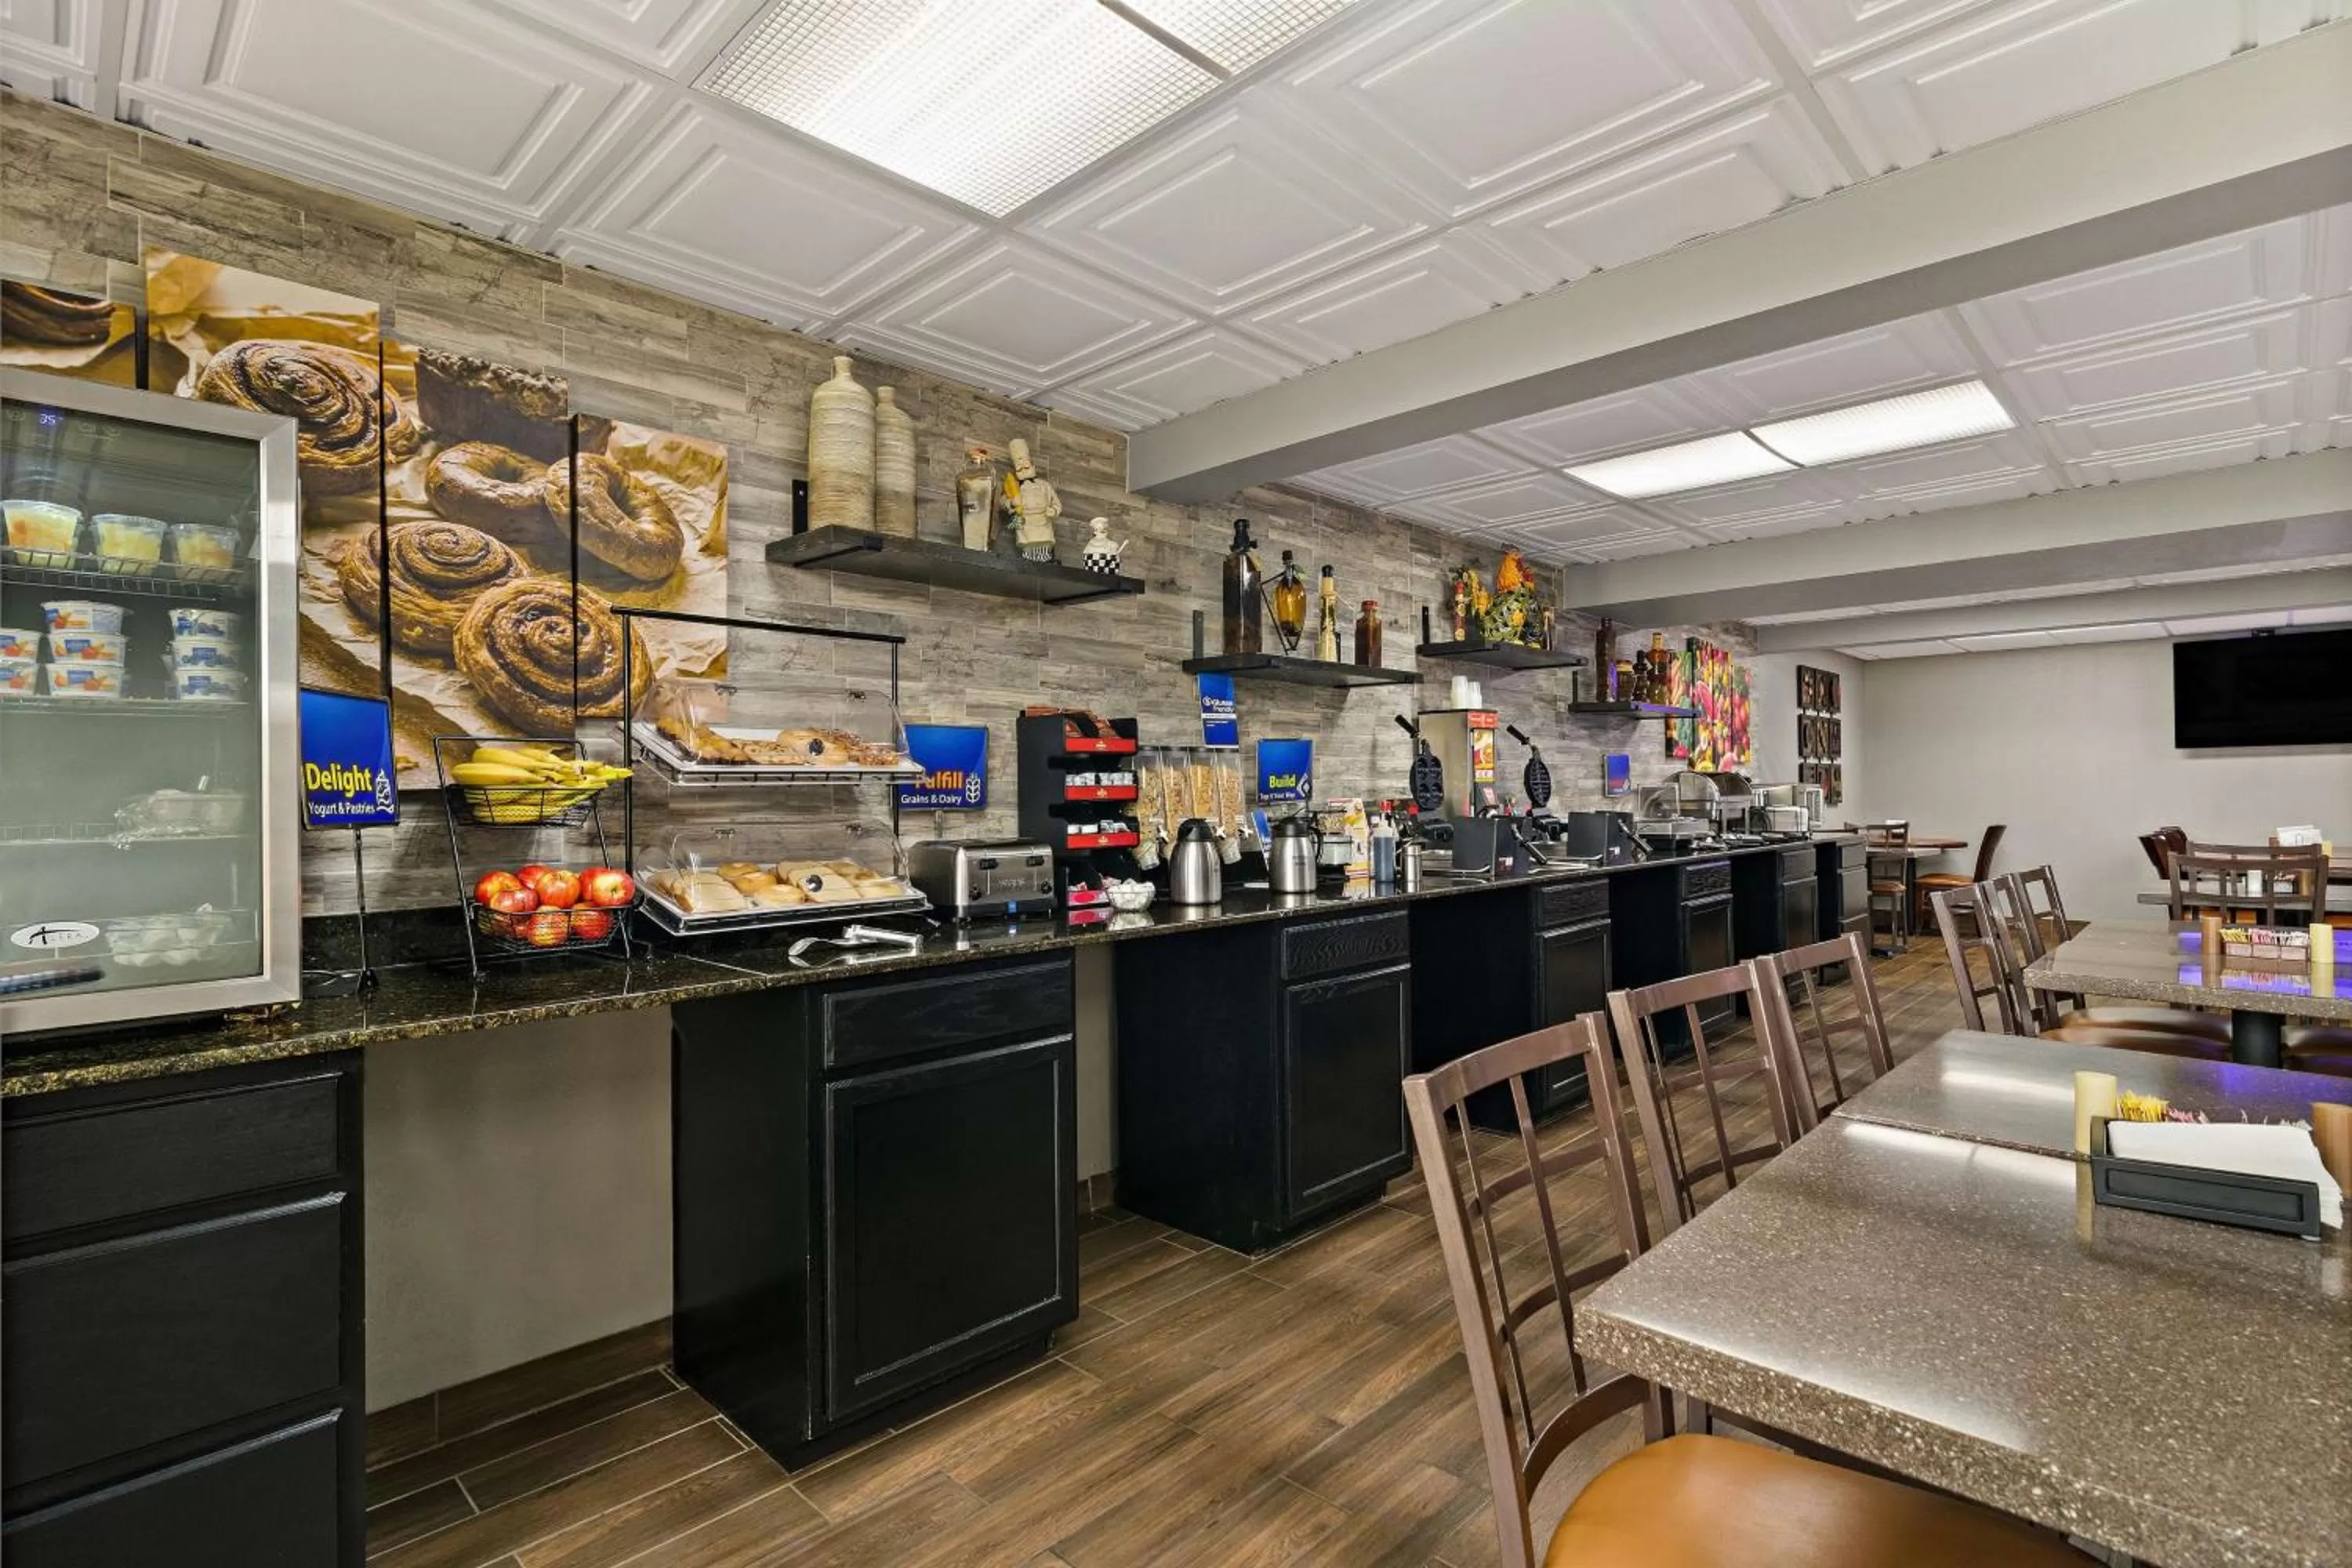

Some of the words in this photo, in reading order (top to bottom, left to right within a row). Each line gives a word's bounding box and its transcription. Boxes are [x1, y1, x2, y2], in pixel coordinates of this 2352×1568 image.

[306, 763, 372, 797] Delight
[1269, 774, 1296, 789] Build
[901, 794, 929, 804] Grains
[931, 795, 938, 804] &
[938, 794, 962, 805] Dairy
[308, 802, 337, 817] Yogurt
[338, 802, 345, 814] &
[345, 802, 376, 814] Pastries
